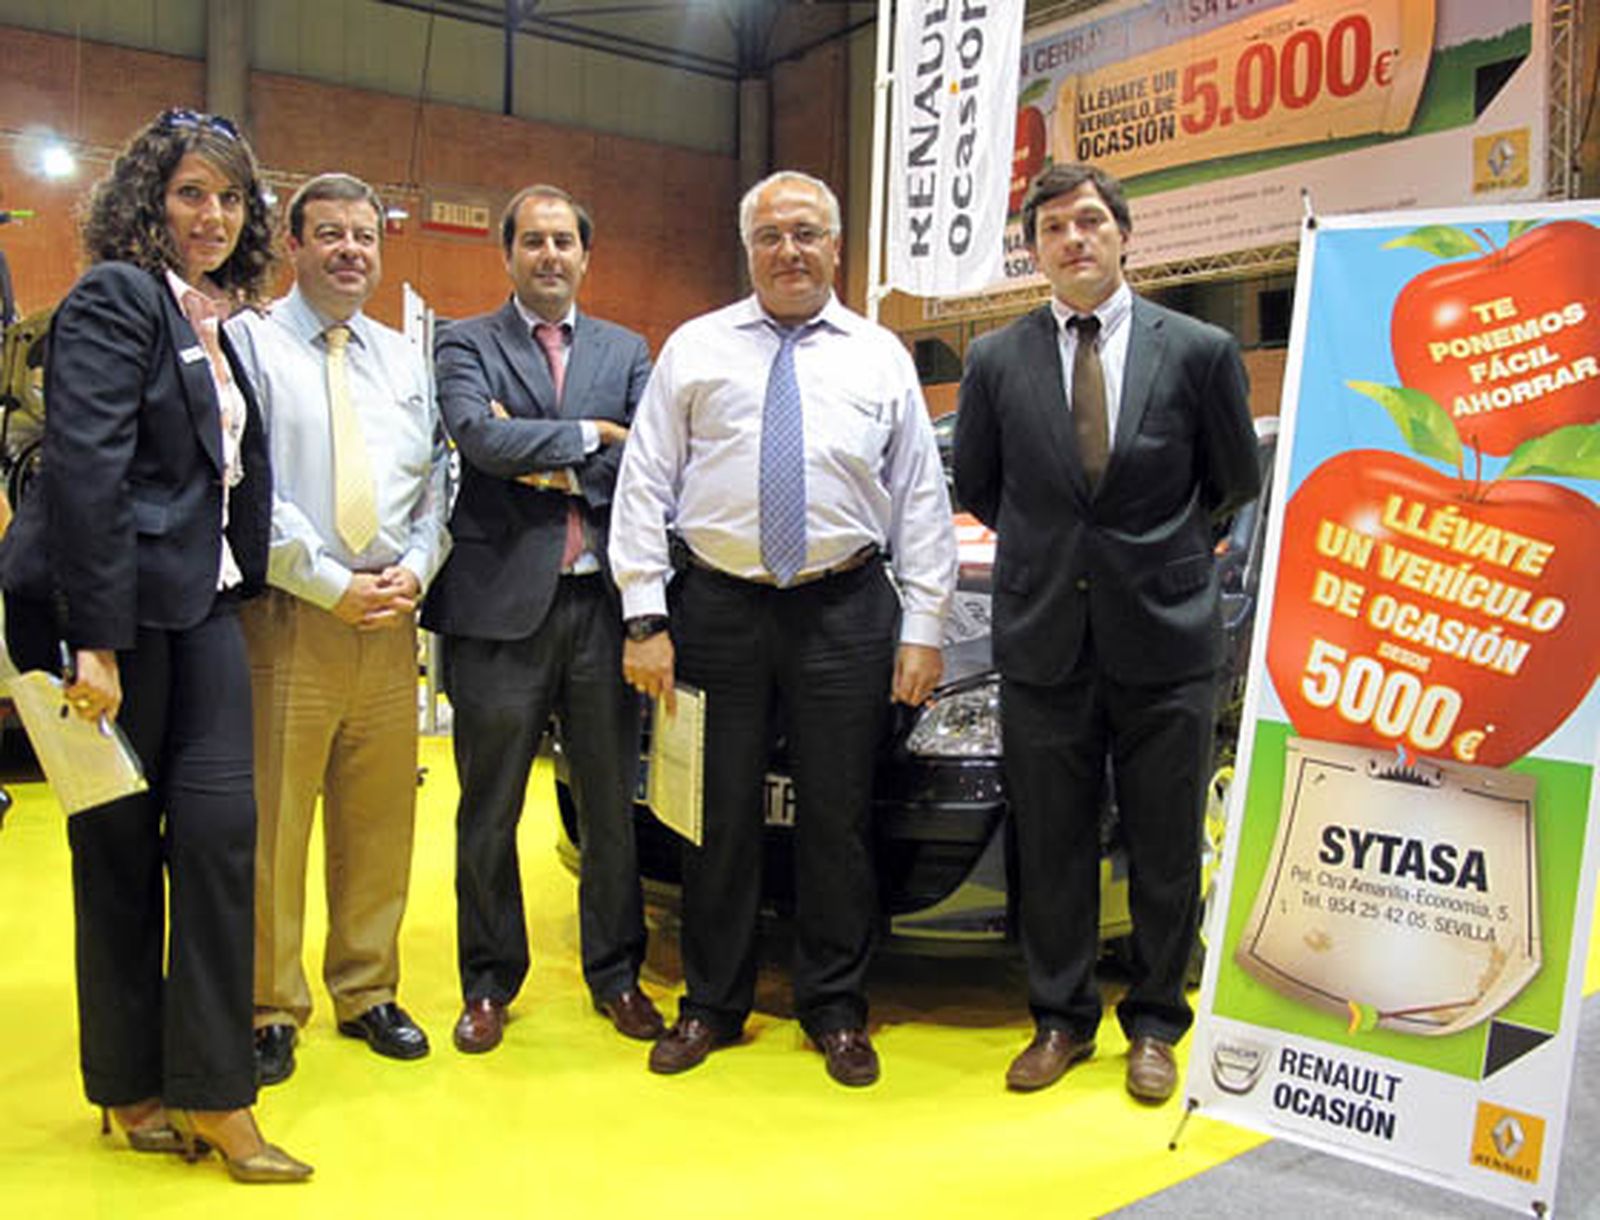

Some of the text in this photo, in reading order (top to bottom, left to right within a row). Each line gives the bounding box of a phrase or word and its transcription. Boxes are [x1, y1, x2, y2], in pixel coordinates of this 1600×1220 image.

[907, 0, 949, 257] RENAUL
[1428, 303, 1586, 363] PONEMOS
[1470, 297, 1518, 323] TE
[1452, 357, 1600, 418] AHORRAR
[1469, 344, 1560, 383] FÁCIL
[1382, 494, 1554, 576] LLÉVATE
[1316, 519, 1565, 631] UN VEHÍCULO
[1311, 569, 1365, 617] DE
[1369, 594, 1531, 675] OCASIÓN
[1318, 825, 1488, 892] SYTASA
[1327, 897, 1356, 914] 954
[1434, 917, 1496, 942] SEVILLA
[1278, 1047, 1402, 1104] RENAULT
[1273, 1082, 1396, 1142] OCASIÓN
